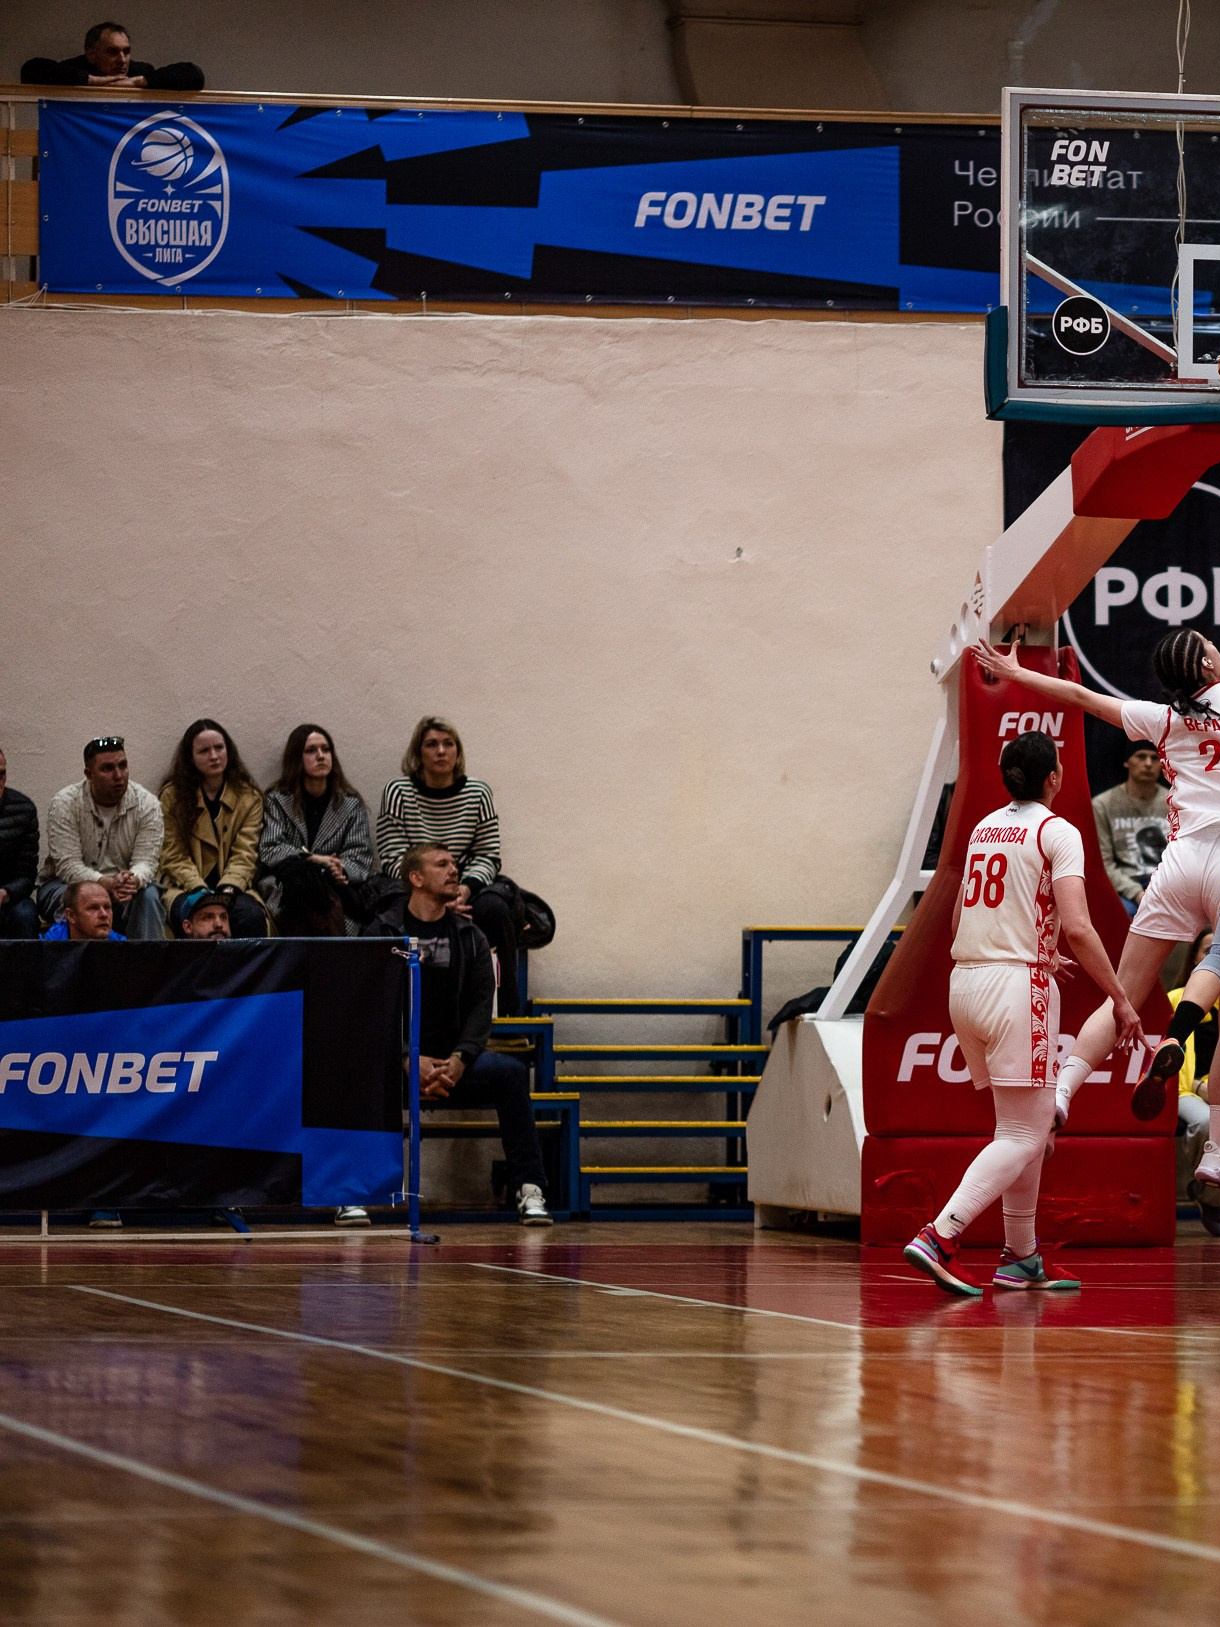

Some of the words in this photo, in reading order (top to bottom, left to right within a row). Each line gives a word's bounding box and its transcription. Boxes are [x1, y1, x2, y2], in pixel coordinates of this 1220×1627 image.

[1050, 139, 1110, 163] FON
[1050, 163, 1108, 187] BET
[137, 199, 203, 213] FONBET
[634, 191, 826, 231] FONBET
[125, 218, 212, 247] ВЫСШАЯ
[154, 247, 183, 263] ЛИГА
[1060, 316, 1103, 334] РФБ
[998, 711, 1064, 737] FON
[963, 852, 1008, 909] 58
[0, 1051, 219, 1094] FONBET
